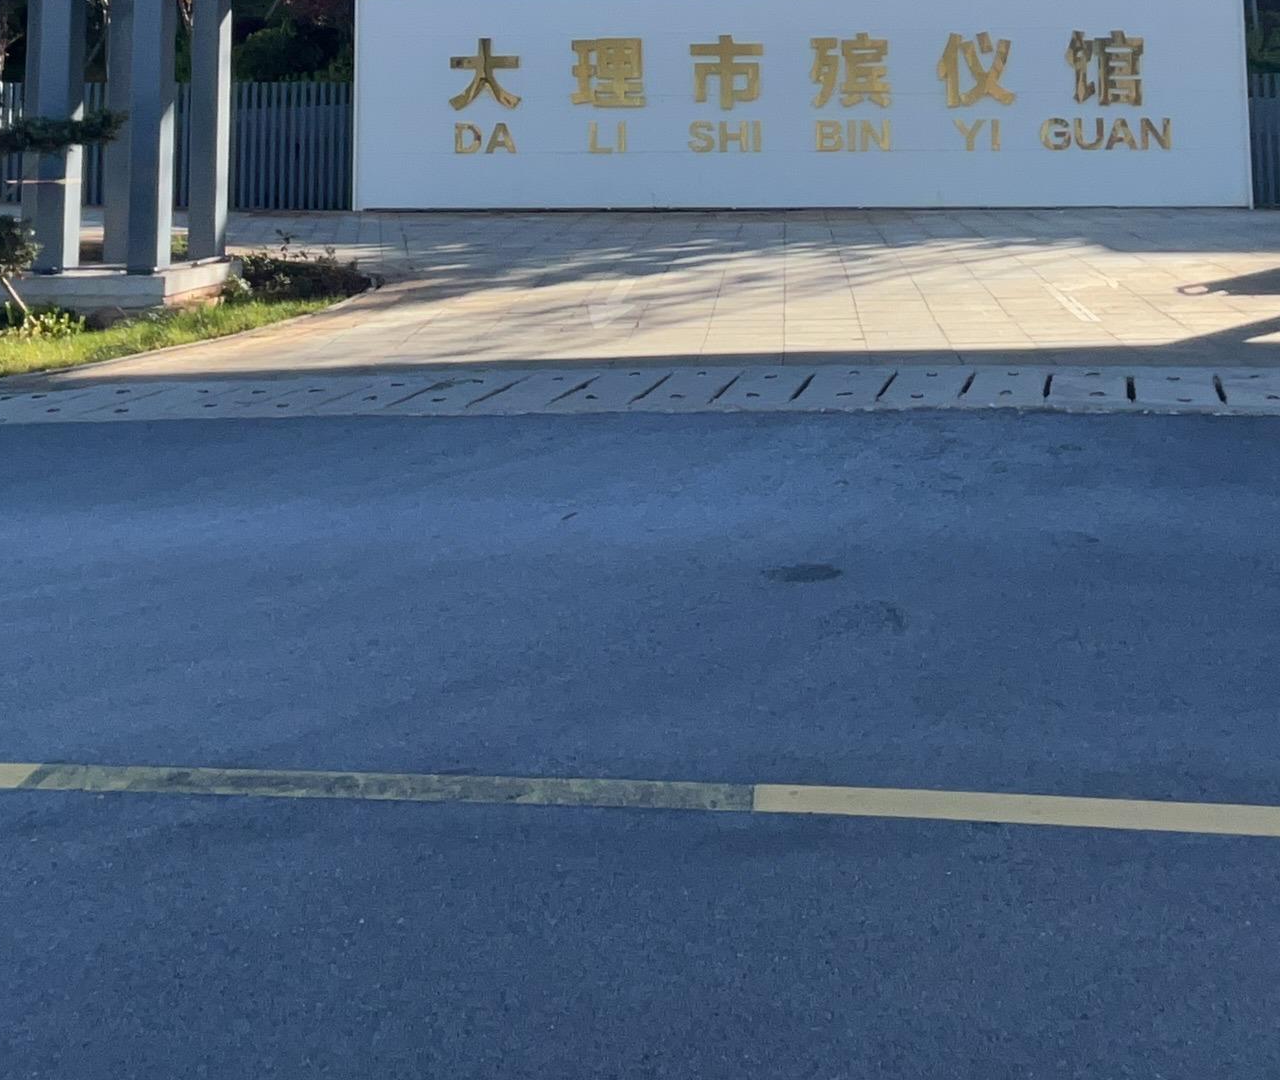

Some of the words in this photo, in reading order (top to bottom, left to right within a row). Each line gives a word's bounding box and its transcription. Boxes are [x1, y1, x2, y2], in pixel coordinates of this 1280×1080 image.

[448, 29, 1145, 111] 大理市殡仪馆
[454, 122, 517, 155] DA
[588, 120, 627, 155] LI
[687, 120, 763, 154] SHI
[815, 119, 892, 153] BIN
[952, 118, 1001, 152] YI
[1039, 117, 1172, 151] GUAN
